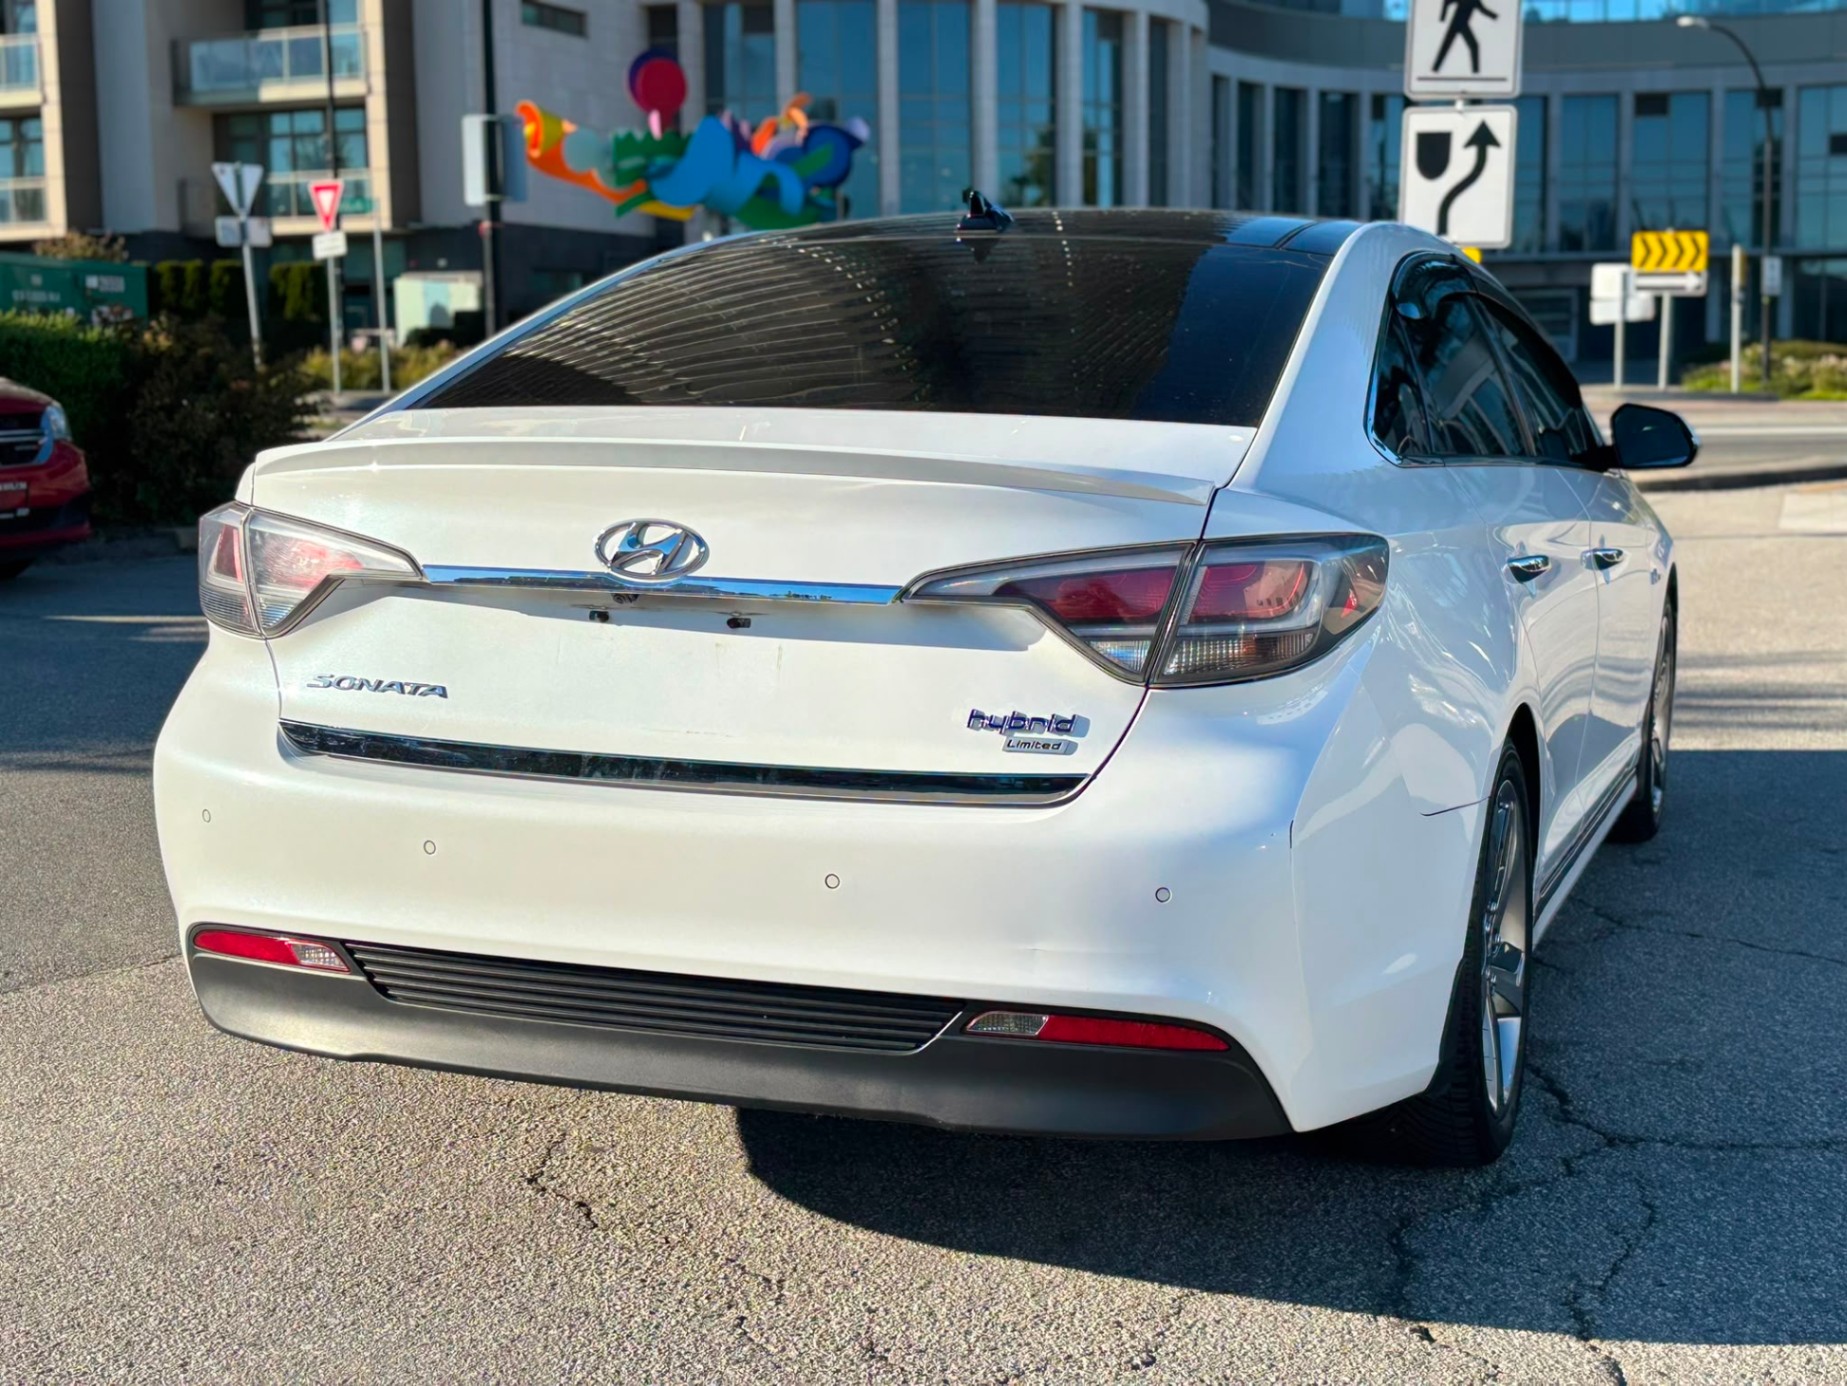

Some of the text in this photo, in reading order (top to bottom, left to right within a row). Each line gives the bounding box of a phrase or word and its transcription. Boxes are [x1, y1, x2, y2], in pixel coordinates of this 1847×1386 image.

[306, 674, 449, 699] SONATA
[967, 708, 1077, 736] hybrid
[1006, 738, 1063, 751] Limited
